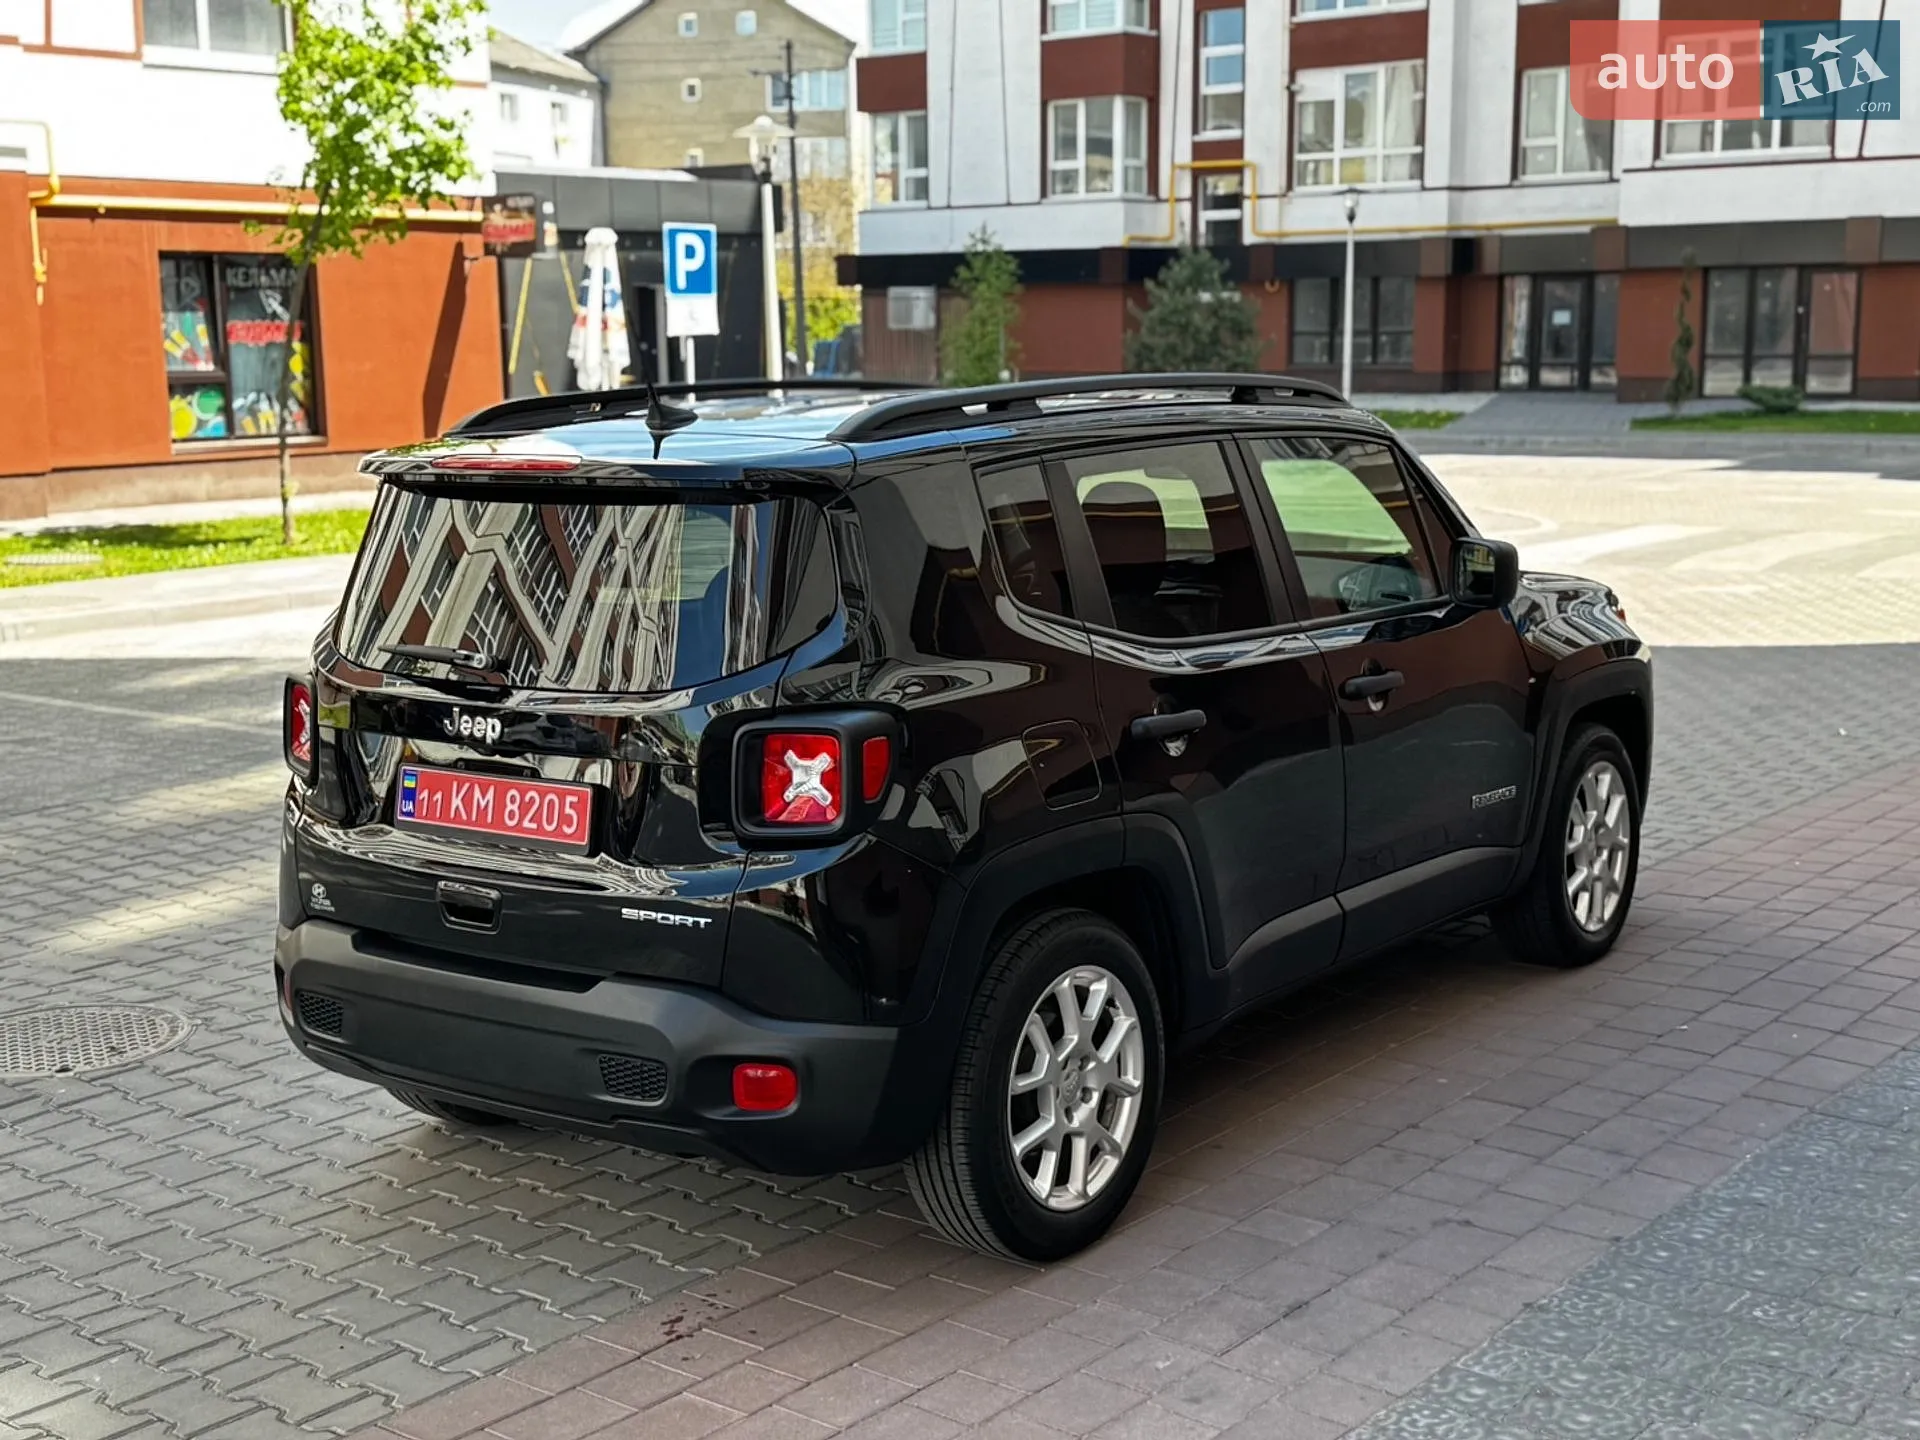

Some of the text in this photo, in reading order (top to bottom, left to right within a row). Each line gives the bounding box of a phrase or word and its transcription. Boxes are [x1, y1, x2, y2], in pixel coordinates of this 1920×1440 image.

[675, 232, 706, 290] P
[443, 707, 502, 745] Jeep
[402, 799, 414, 813] UA
[419, 781, 579, 835] 11 KM 8205
[621, 908, 712, 929] SPORT
